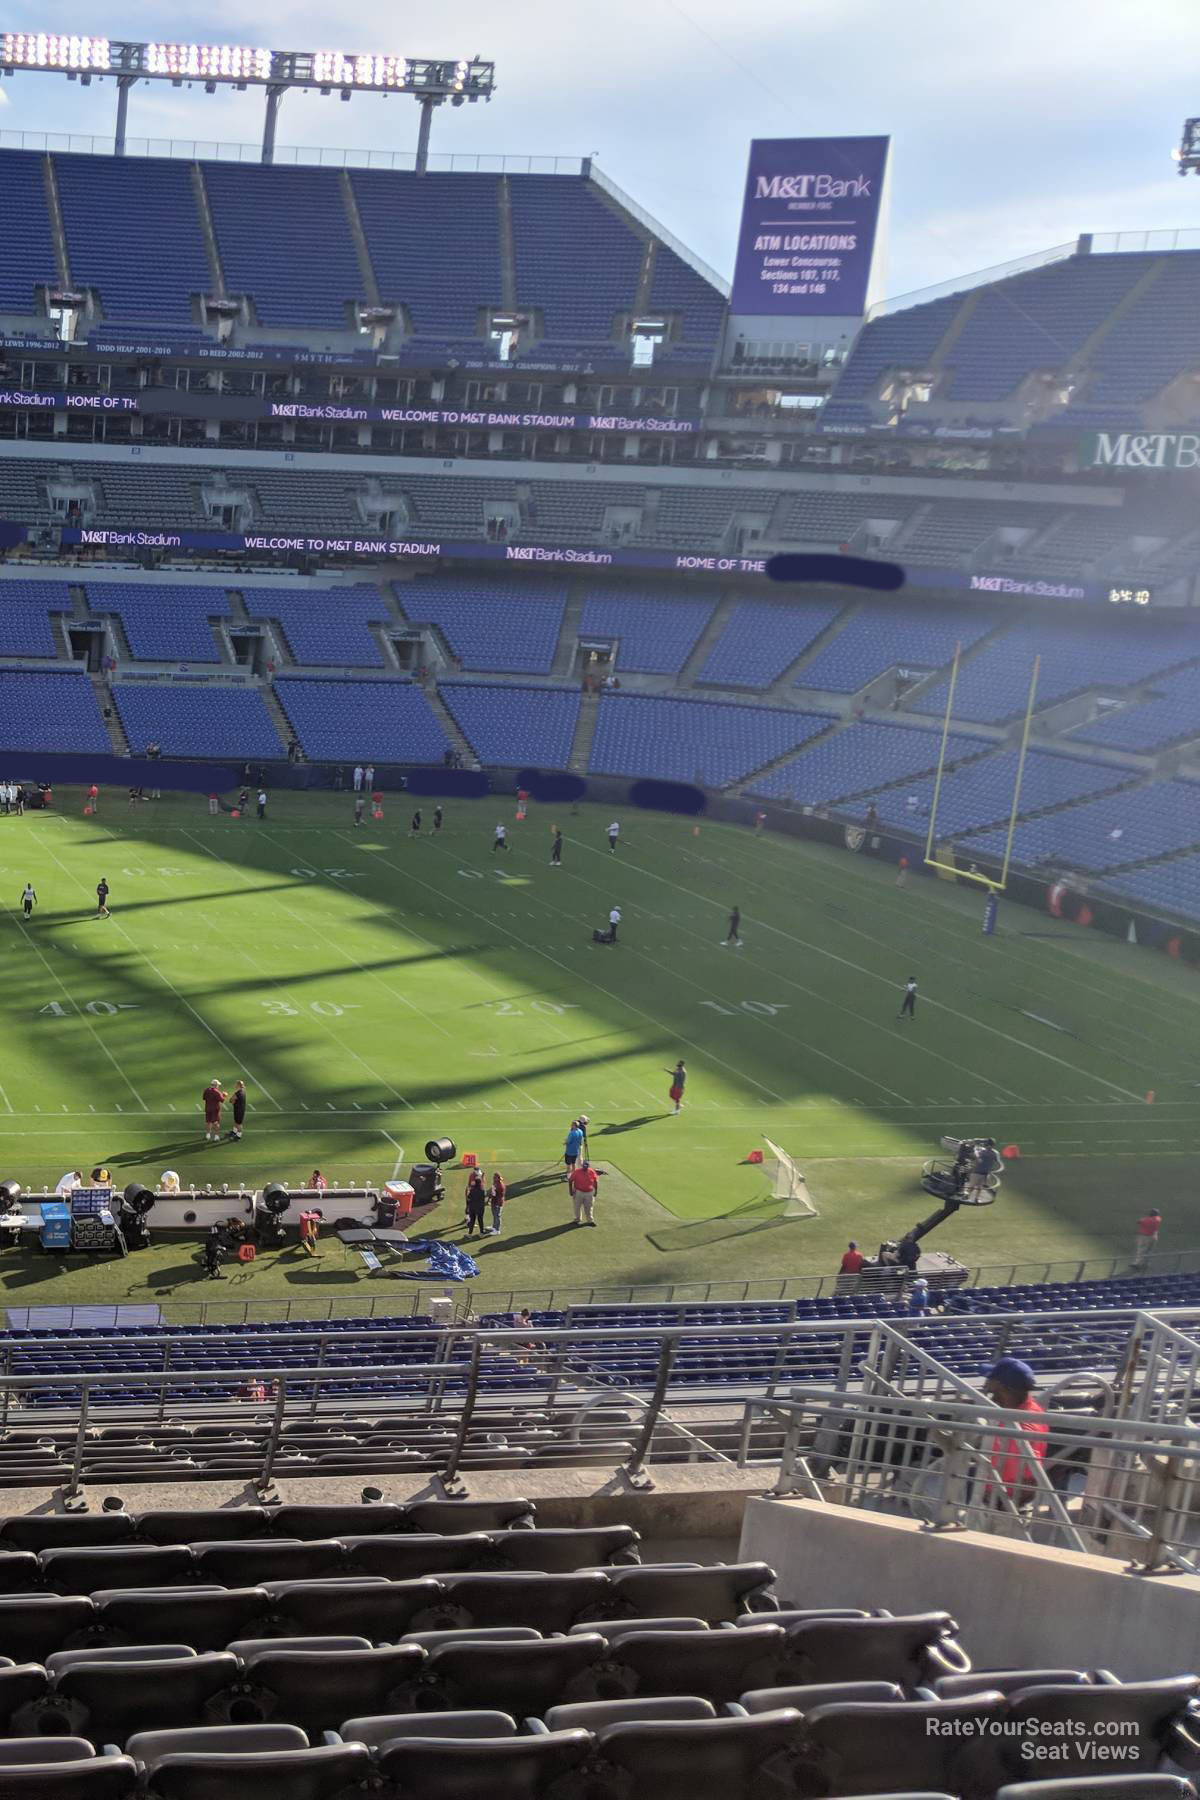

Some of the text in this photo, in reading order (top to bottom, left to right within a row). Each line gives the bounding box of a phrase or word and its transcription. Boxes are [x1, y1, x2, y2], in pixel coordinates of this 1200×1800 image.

[754, 173, 871, 199] M&T Bank
[754, 235, 857, 250] ATM LOCATIONS
[764, 256, 789, 266] Lower
[760, 270, 798, 280] Sections
[790, 284, 807, 293] and
[5, 340, 23, 348] LEWIS
[96, 344, 115, 352] TODD
[116, 345, 134, 353] HEAP
[209, 349, 226, 357] REED
[12, 391, 55, 406] Stadium
[67, 395, 137, 409] HOME OF TH
[272, 404, 367, 420] M&T Bank Stadium
[381, 409, 574, 427] WELCOME TO M&T BANK STADIUM
[589, 416, 692, 432] M&T Bank Stadium
[1093, 433, 1200, 468] M&T B
[80, 529, 181, 547] M&T Bank Stadium
[244, 537, 440, 555] WELCOME TO M&T BANK STADIUM
[506, 546, 612, 564] M&T Bank Stadium
[676, 556, 766, 572] HOME OF THE
[970, 575, 1084, 599] M&T Bank Stadium
[39, 1000, 120, 1018] 40
[260, 1000, 347, 1017] 30
[241, 1246, 255, 1260] 40
